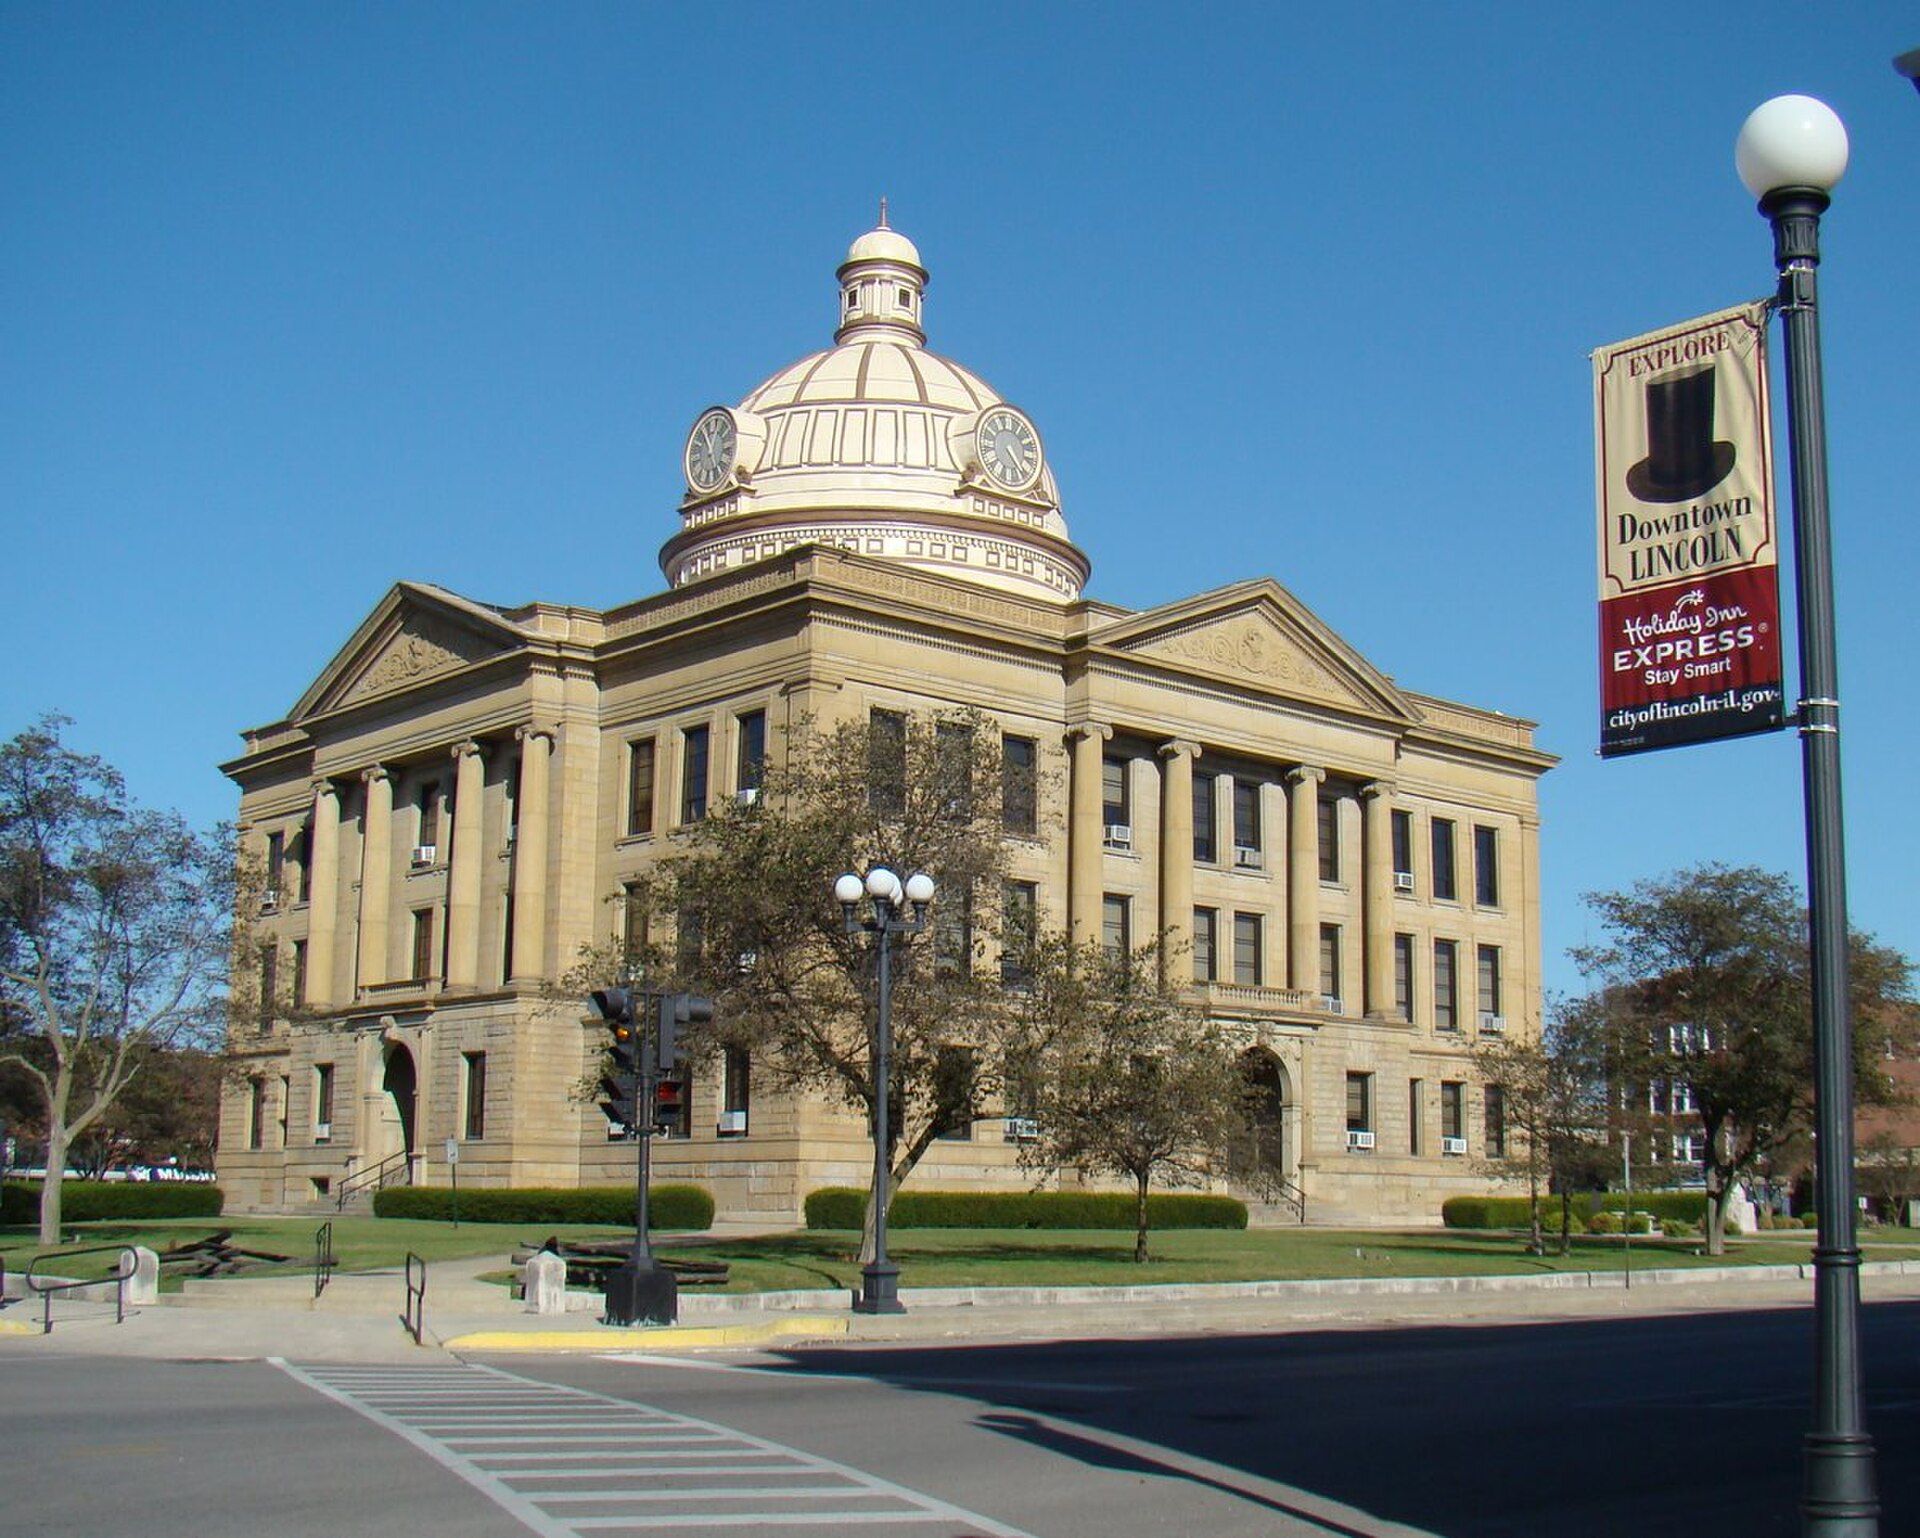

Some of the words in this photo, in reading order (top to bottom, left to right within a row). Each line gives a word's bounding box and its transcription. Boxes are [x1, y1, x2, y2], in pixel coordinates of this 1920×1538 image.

[1629, 331, 1729, 377] EXPLORE
[1618, 496, 1752, 544] Downtown
[1630, 525, 1741, 581] LINCOLN
[1623, 610, 1702, 645] Holiday
[1705, 605, 1747, 627] Inn
[1614, 625, 1755, 672] EXPRESS
[1645, 668, 1679, 685] Stay
[1684, 657, 1731, 679] Smart
[1609, 689, 1776, 730] cityoflincoln-il.gov
